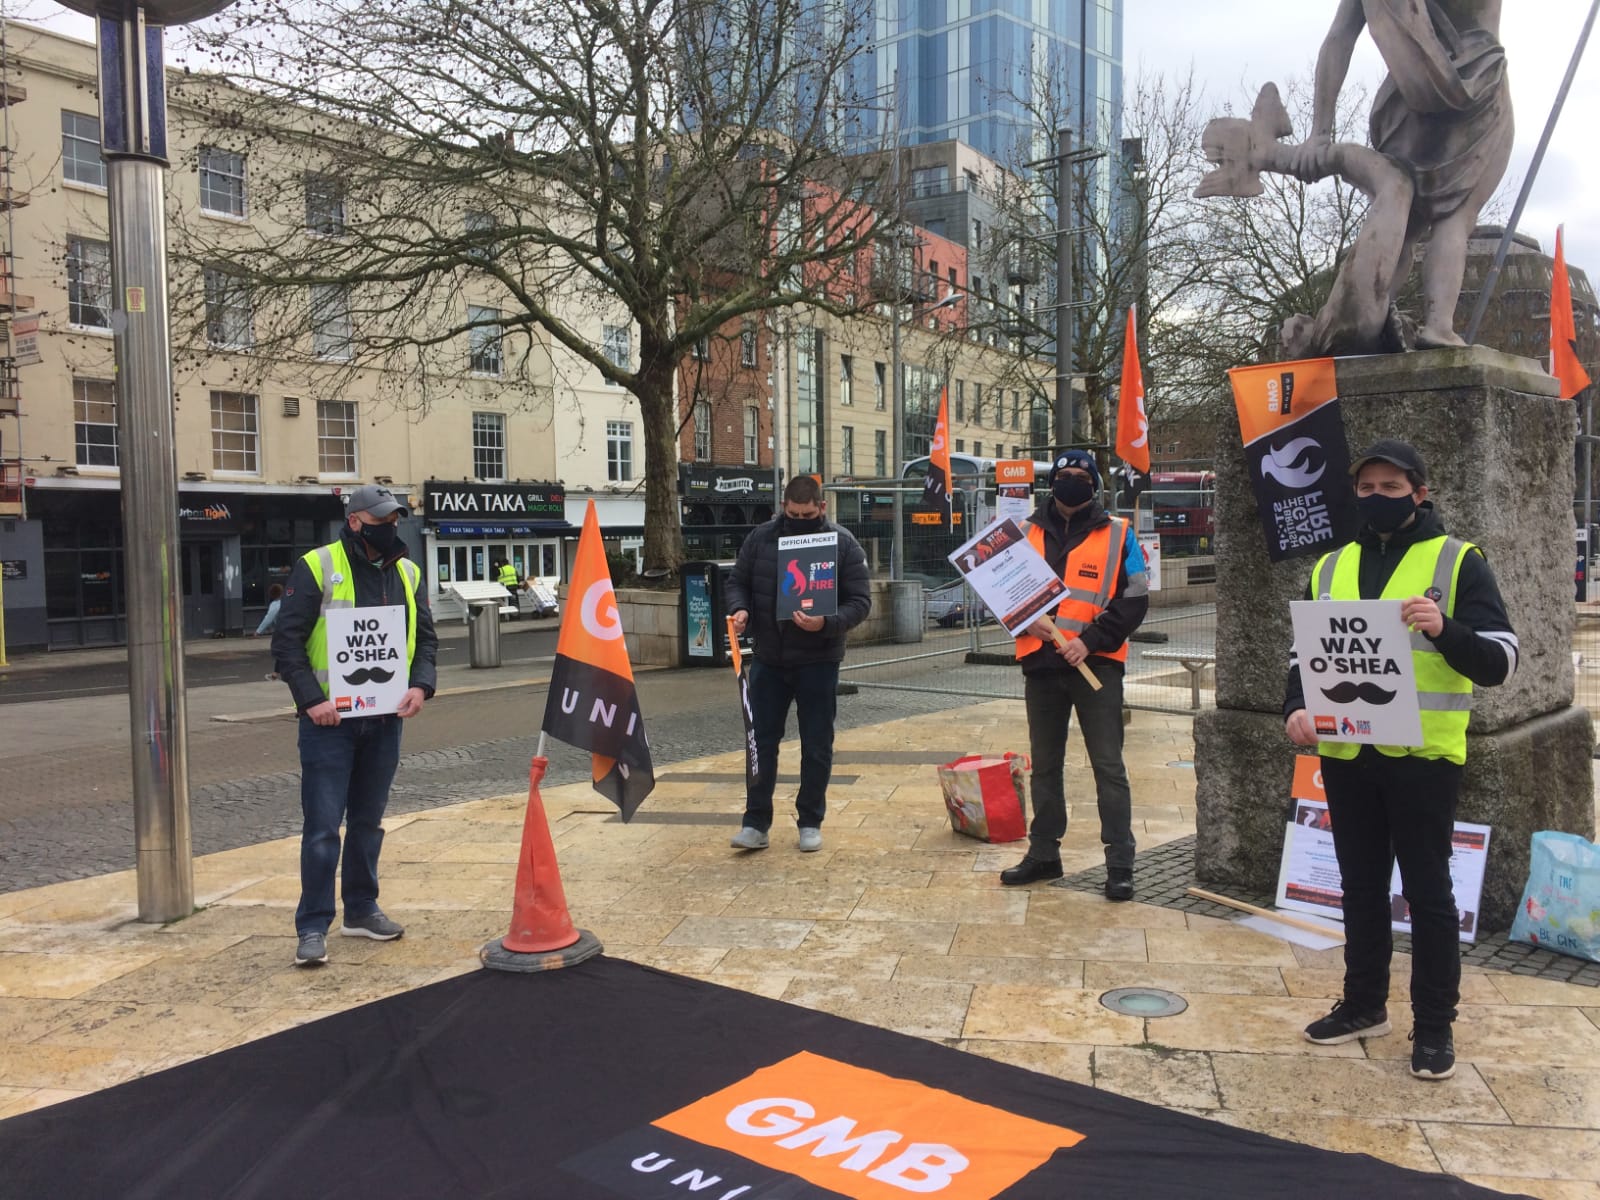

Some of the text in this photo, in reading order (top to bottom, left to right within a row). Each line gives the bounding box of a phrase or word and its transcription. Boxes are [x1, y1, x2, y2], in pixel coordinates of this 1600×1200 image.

[1003, 466, 1026, 478] GMB
[430, 492, 526, 512] TAKA TAKA
[527, 494, 544, 502] GRILL
[781, 535, 836, 546] OFFICIAL PICKET
[810, 561, 835, 571] STOP
[809, 578, 835, 591] FIRE
[353, 619, 380, 632] NO
[1329, 617, 1368, 634] NO
[346, 633, 388, 648] WAY
[1320, 637, 1382, 654] WAY
[336, 647, 399, 664] O'SHEA
[1309, 655, 1402, 675] O'SHEA
[561, 687, 648, 746] UNI
[725, 1097, 971, 1193] GMB
